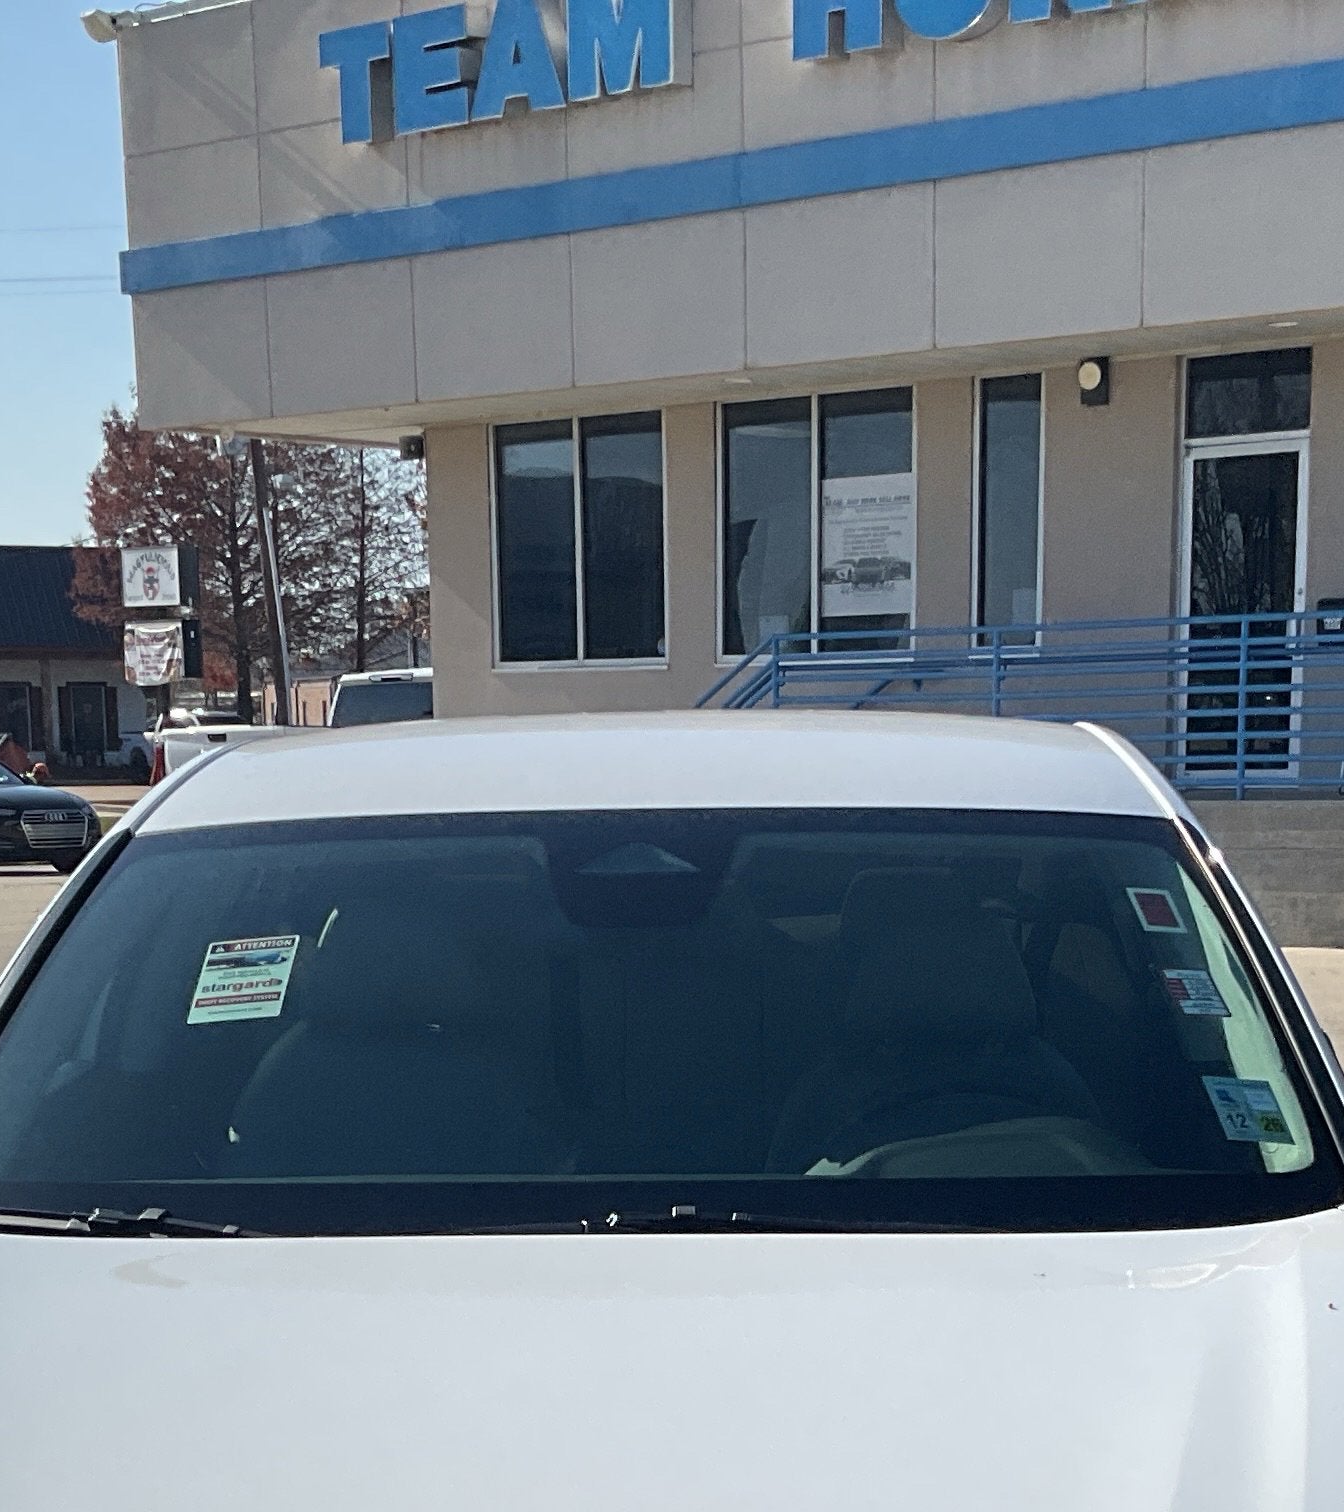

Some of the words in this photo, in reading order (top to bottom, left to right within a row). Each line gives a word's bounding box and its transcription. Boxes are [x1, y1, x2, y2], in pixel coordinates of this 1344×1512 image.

[319, 0, 673, 144] TEAM
[235, 939, 293, 951] ATTENTION
[1226, 1114, 1249, 1129] 12
